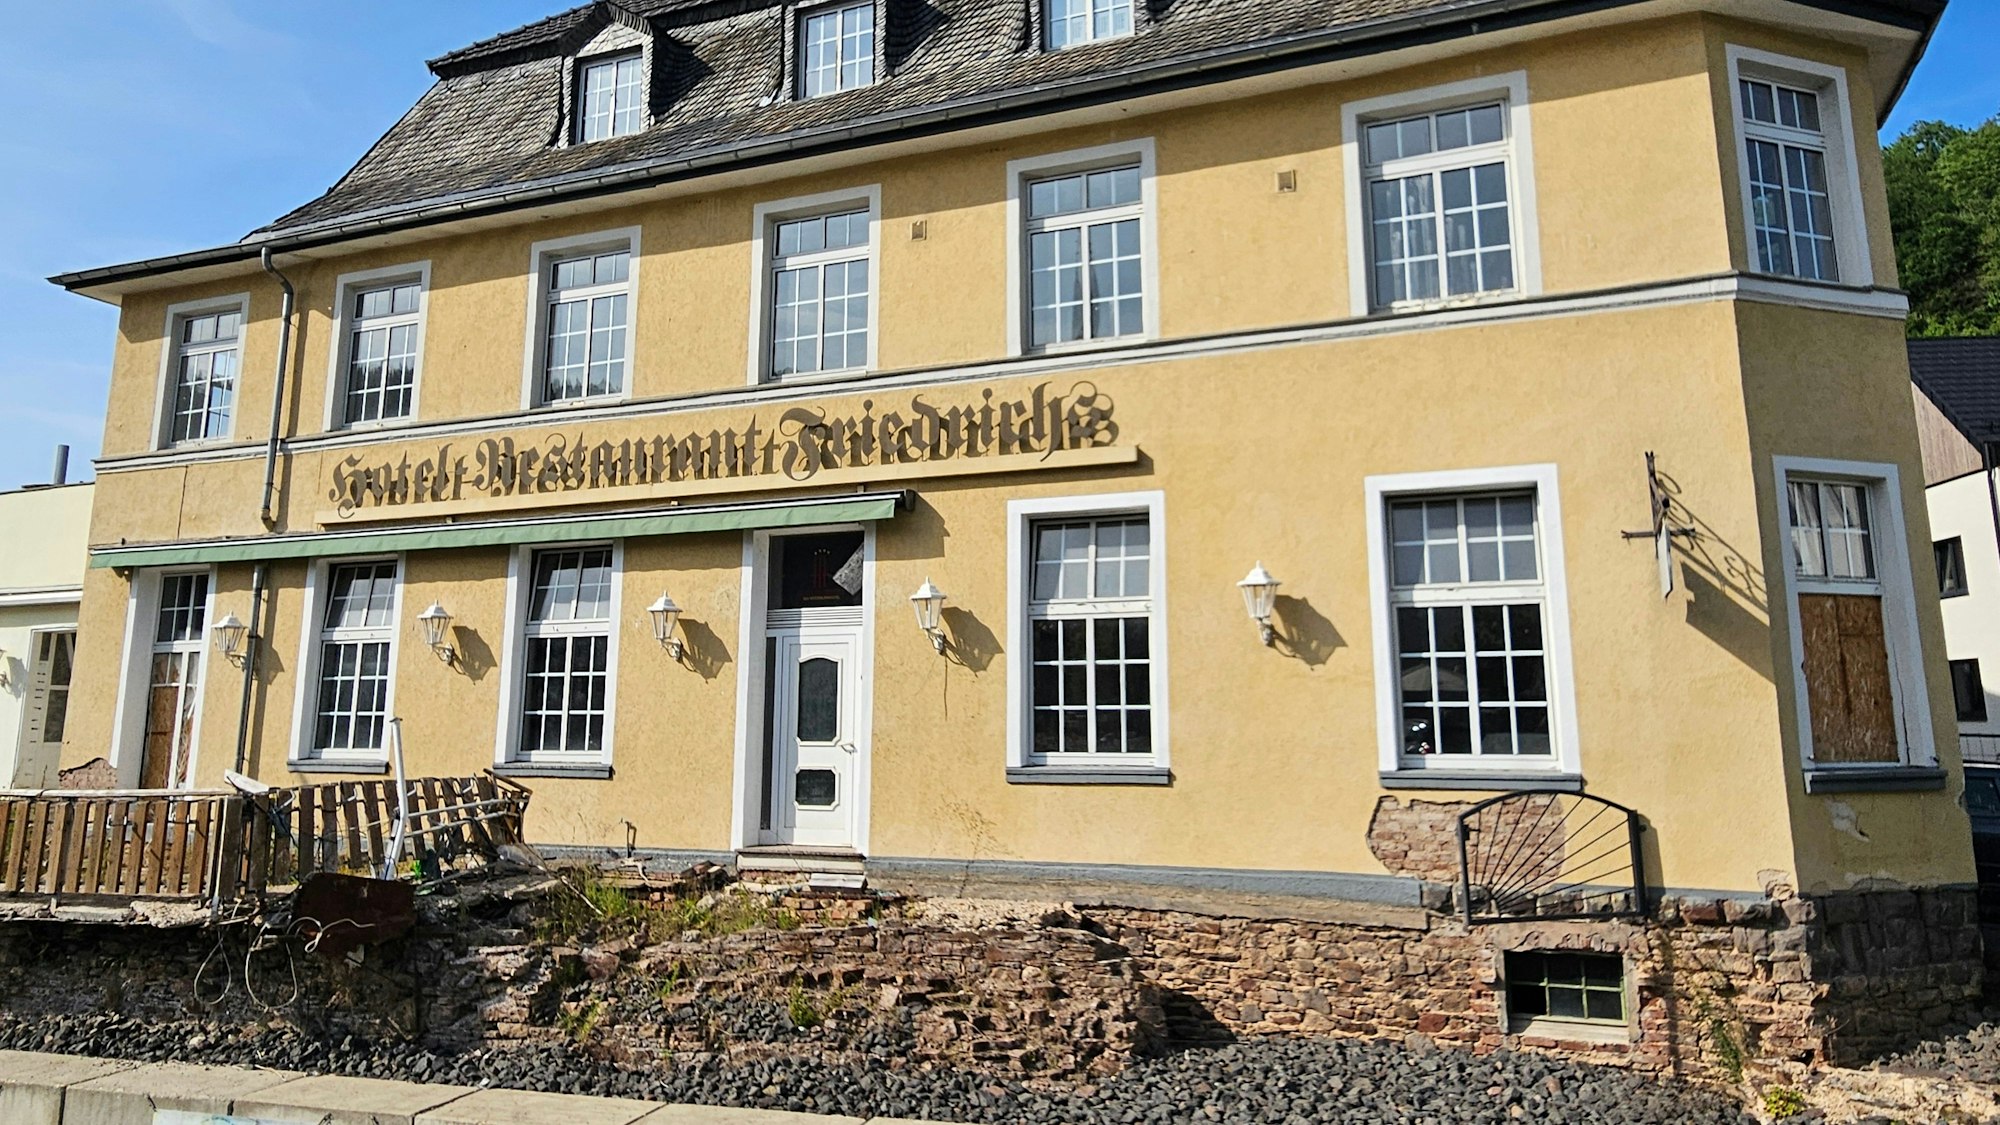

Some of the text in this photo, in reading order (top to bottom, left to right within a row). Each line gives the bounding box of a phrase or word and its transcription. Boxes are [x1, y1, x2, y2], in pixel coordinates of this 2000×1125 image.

[329, 381, 1098, 519] Hotel Restaurant Friedrichs
